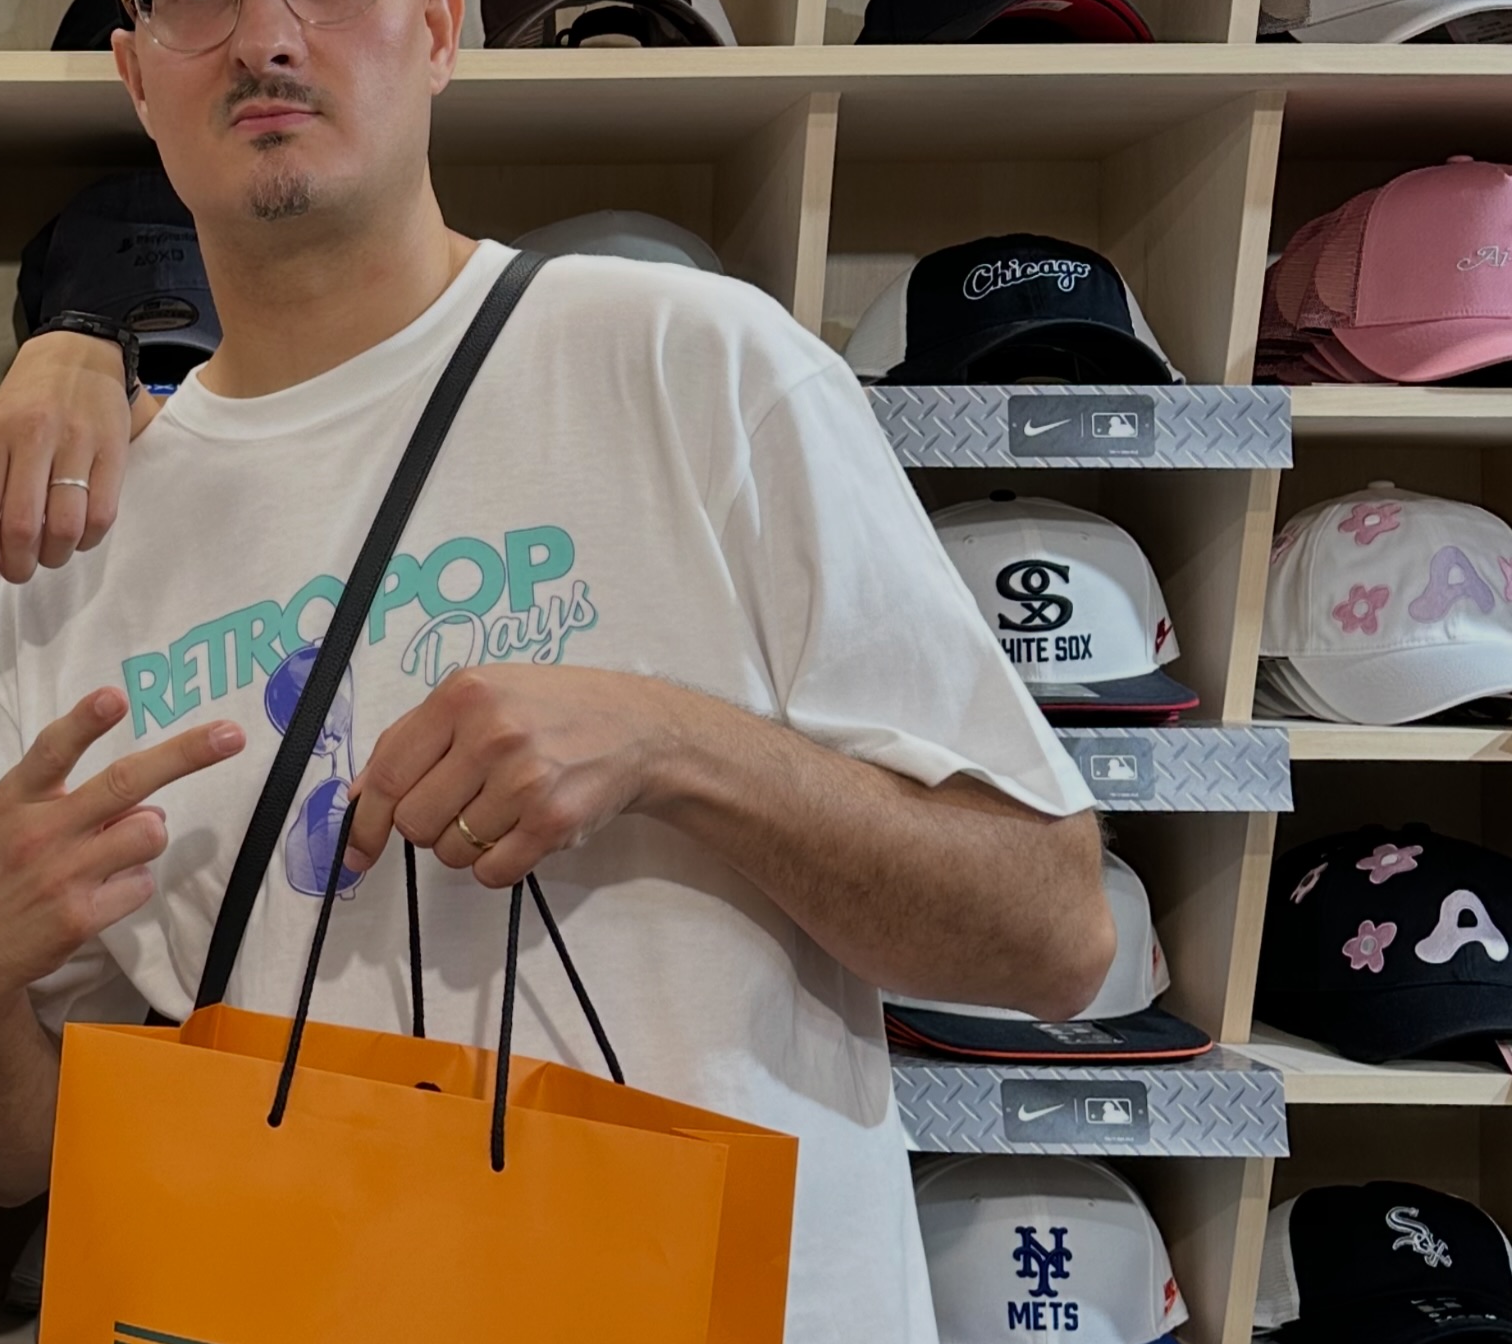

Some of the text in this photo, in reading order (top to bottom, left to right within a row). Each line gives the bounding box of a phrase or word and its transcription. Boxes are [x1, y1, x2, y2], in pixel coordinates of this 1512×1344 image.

[962, 257, 1091, 300] Chicago
[368, 525, 576, 647] POP
[401, 579, 598, 688] Days
[998, 633, 1093, 664] HITE SOX
[1414, 889, 1509, 965] A
[1012, 1226, 1073, 1298] NY
[1007, 1300, 1080, 1333] METS
